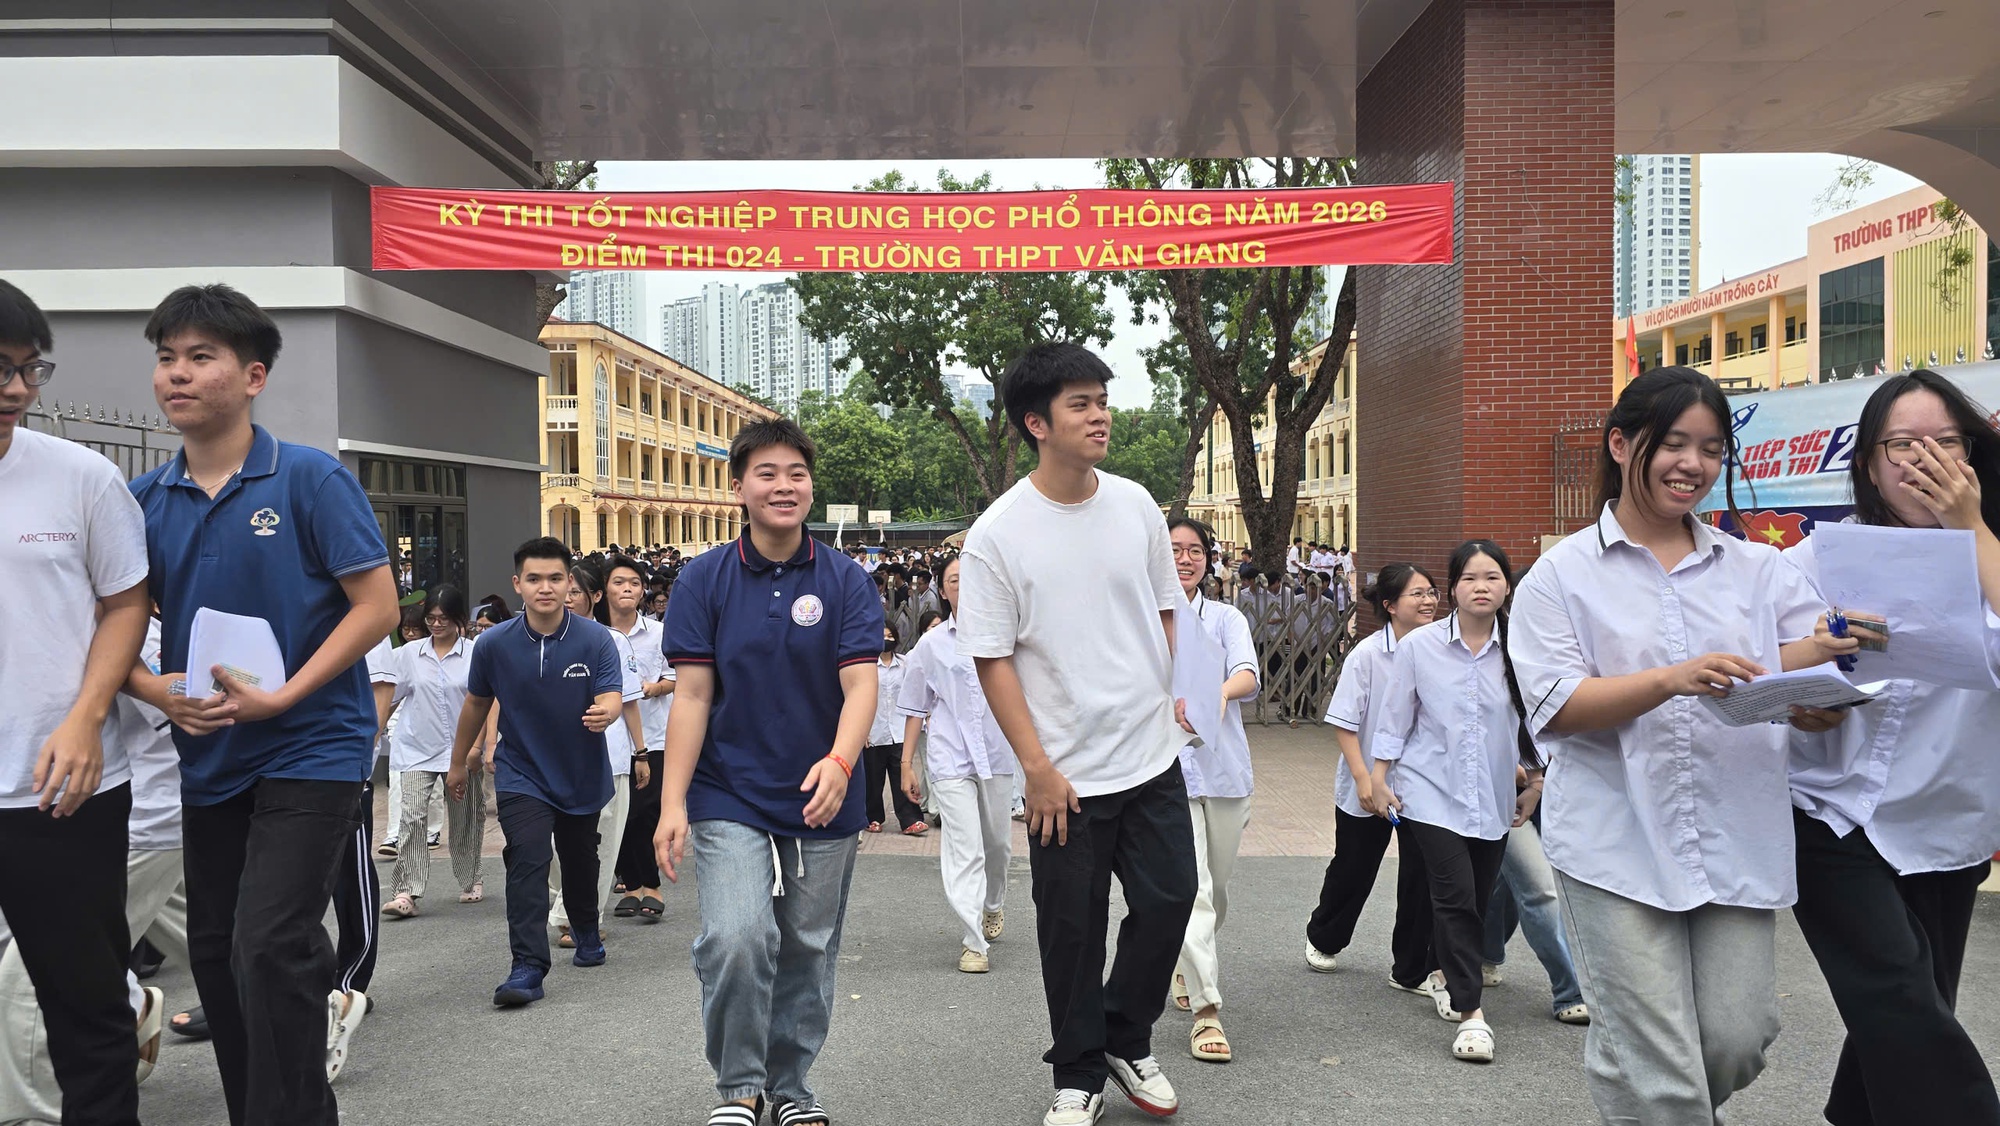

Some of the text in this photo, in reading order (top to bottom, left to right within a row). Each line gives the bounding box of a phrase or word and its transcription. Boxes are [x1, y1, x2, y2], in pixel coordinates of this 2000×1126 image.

[440, 193, 1387, 234] KỲ THI TỐT NGHIỆP TRUNG HỌC PHỔ THÔNG NĂM 2026
[1833, 203, 1936, 254] TRƯỜNG THPT
[561, 232, 646, 268] ĐIỂM
[659, 245, 714, 267] THI
[726, 246, 782, 268] 024
[814, 239, 961, 269] TRƯỜNG
[973, 245, 1063, 268] THPT
[1075, 239, 1144, 269] VĂN
[1156, 241, 1266, 266] GIANG
[1665, 303, 1680, 320] ÍCH
[1680, 297, 1701, 317] MƯỜI
[1702, 291, 1722, 310] NĂM
[1723, 281, 1756, 303] TRỒNG
[1757, 273, 1780, 293] CÂY
[1743, 429, 1831, 463] TIẾP SỨC
[1740, 454, 1821, 480] MÙA THI
